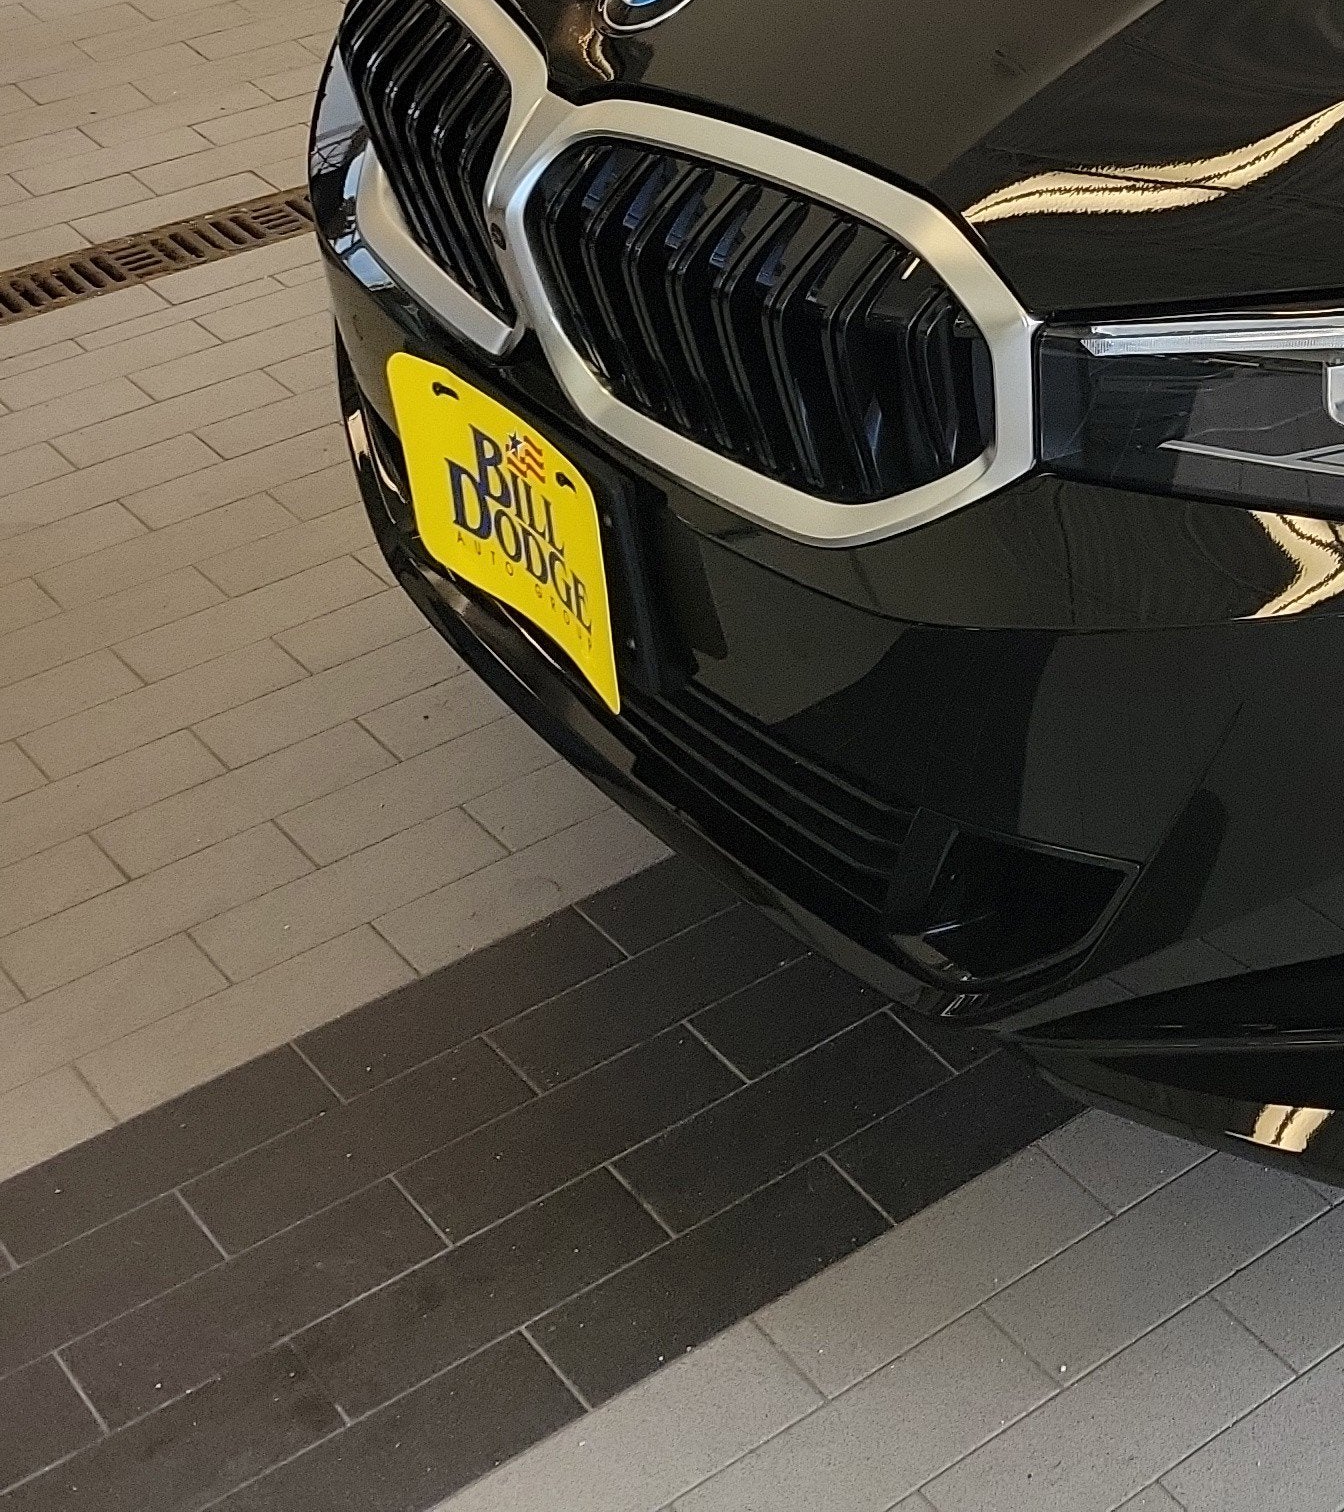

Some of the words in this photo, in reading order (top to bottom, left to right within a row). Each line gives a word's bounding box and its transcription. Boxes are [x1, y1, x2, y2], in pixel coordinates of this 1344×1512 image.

[444, 457, 592, 636] DODGE
[456, 530, 514, 577] AUTO
[468, 422, 566, 560] BILL
